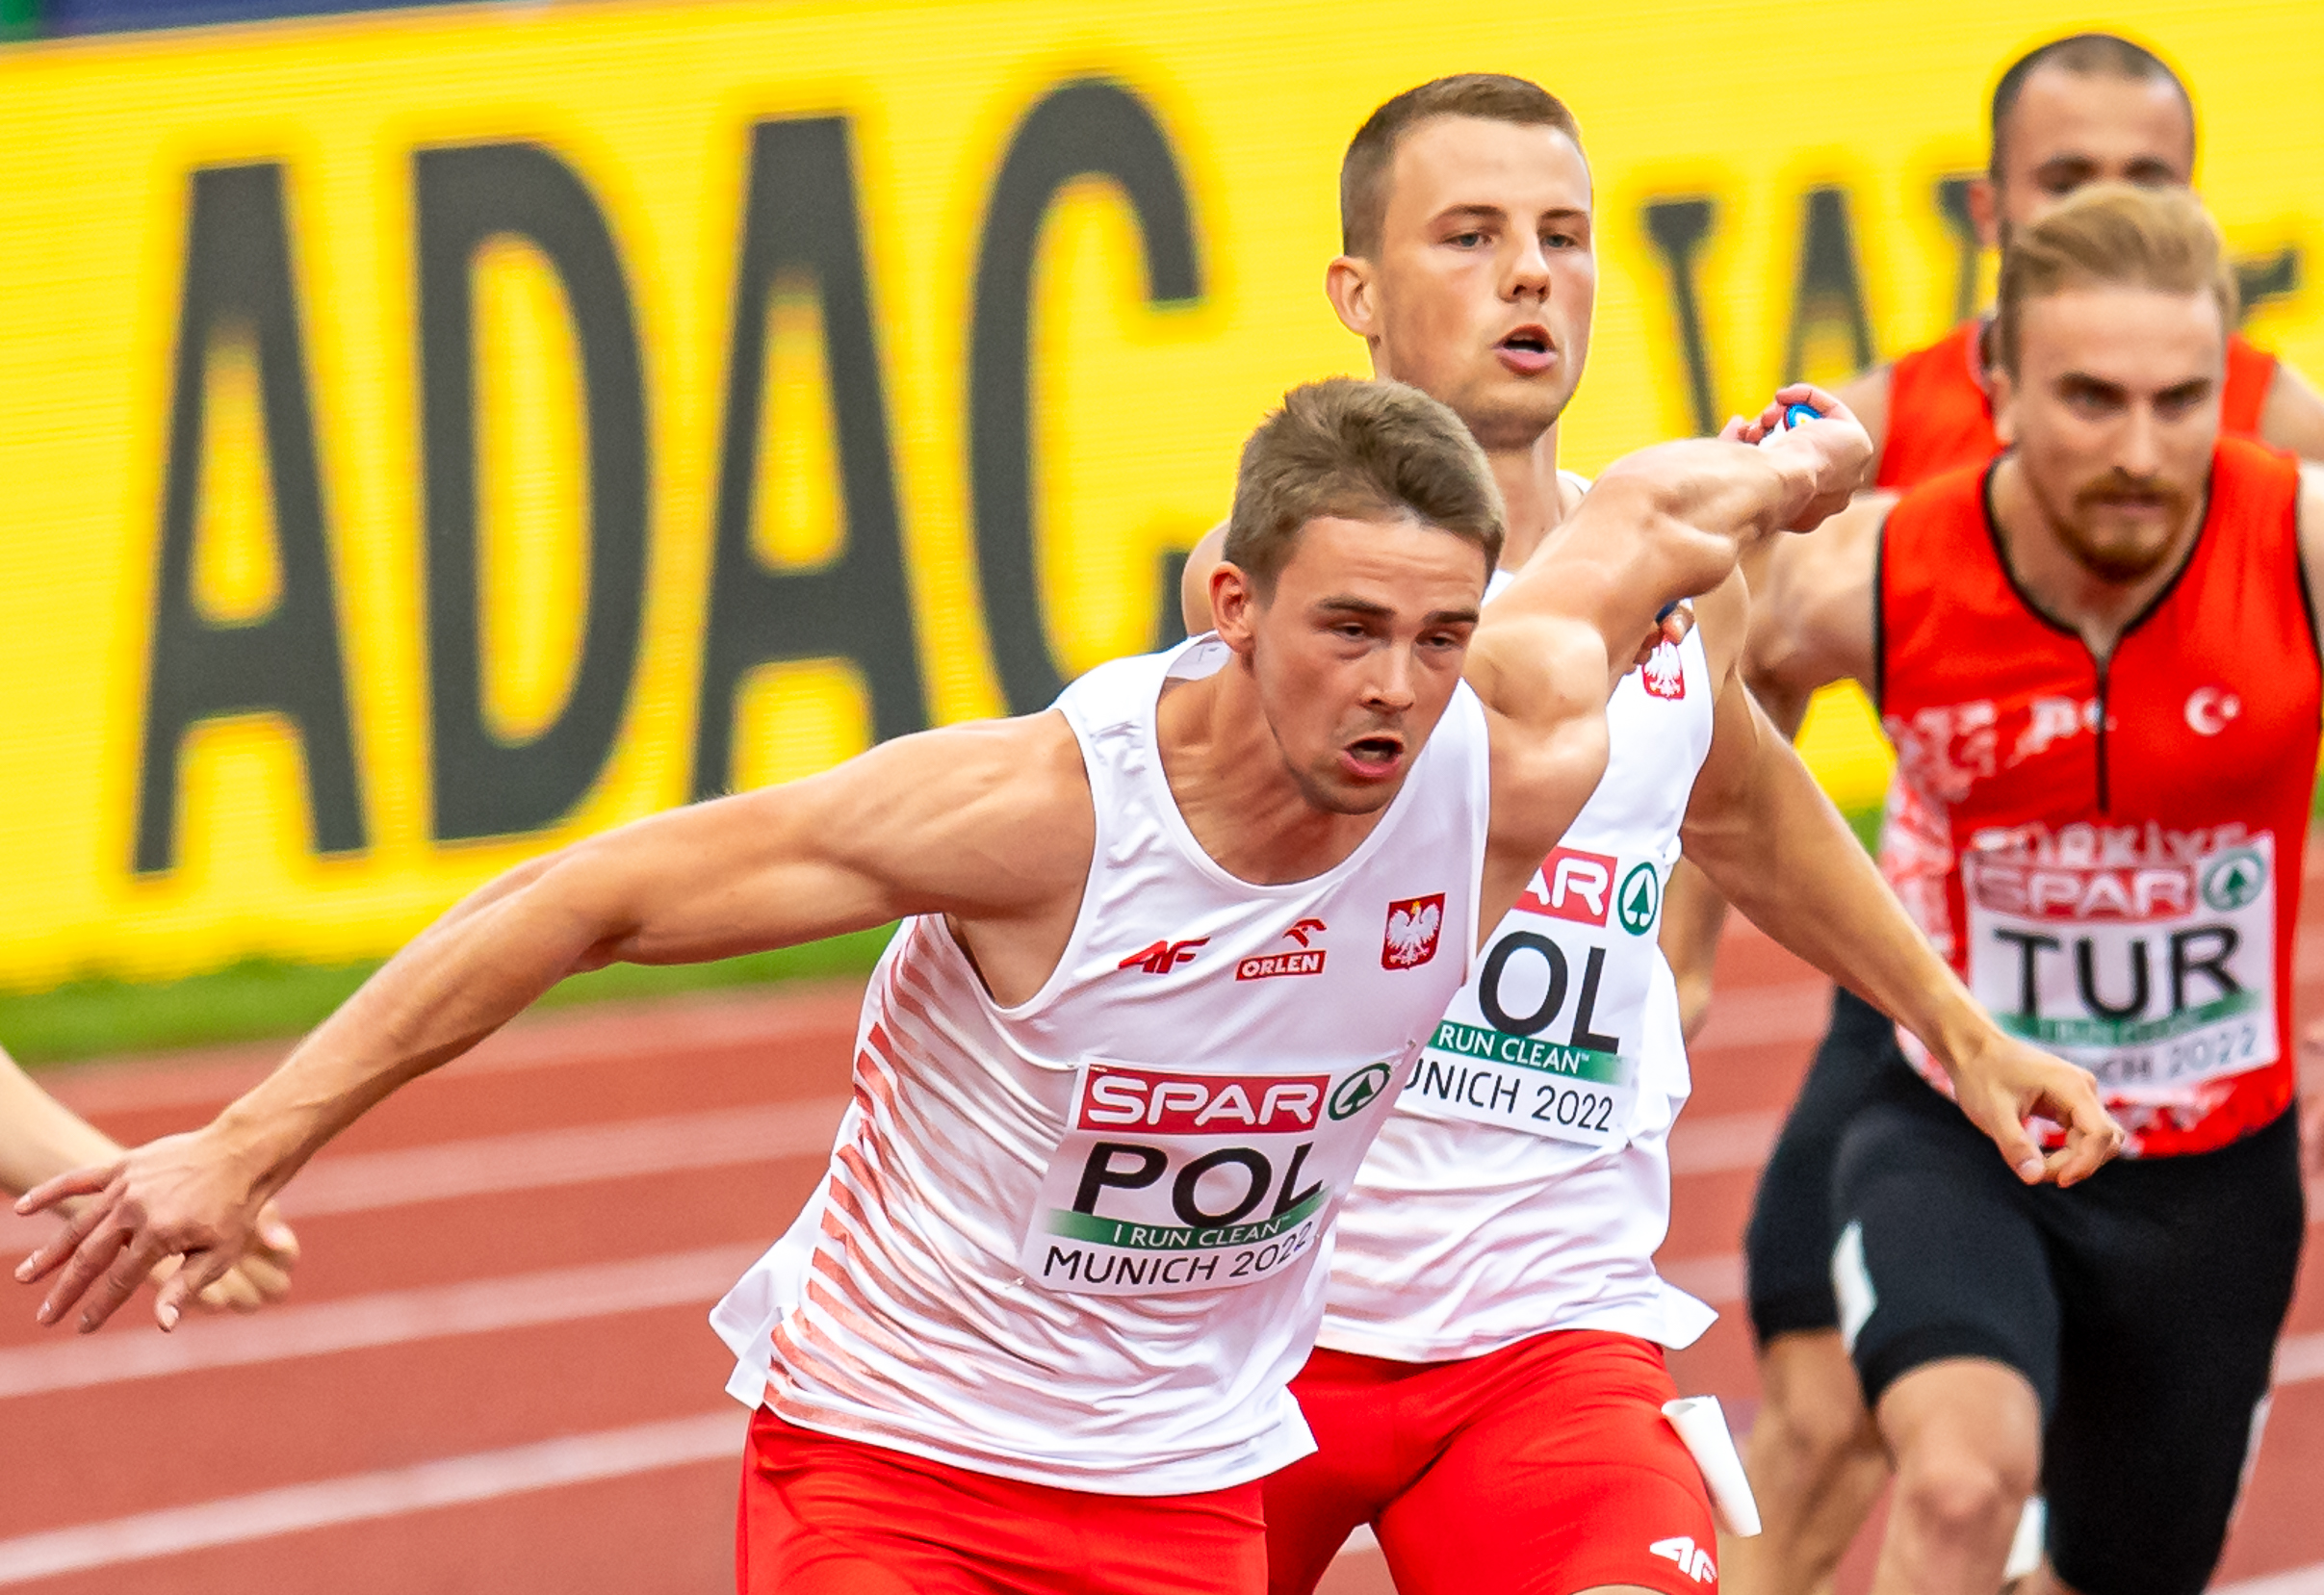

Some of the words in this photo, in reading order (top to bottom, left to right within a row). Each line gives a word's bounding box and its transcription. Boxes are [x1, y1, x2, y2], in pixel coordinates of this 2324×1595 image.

[132, 76, 1207, 874] ADAC
[1241, 952, 1321, 978] ORLEN
[1479, 930, 1620, 1055] OL
[1992, 924, 2243, 1023] TUR
[1437, 1023, 1495, 1057] RUN
[1088, 1074, 1320, 1126] SPAR
[1532, 1085, 1613, 1132] 2022
[1072, 1142, 1324, 1227] POL
[1044, 1246, 1220, 1285] MUNICH
[1229, 1221, 1313, 1278] 2022
[1113, 1223, 1123, 1243] I
[1130, 1226, 1191, 1248] RUN
